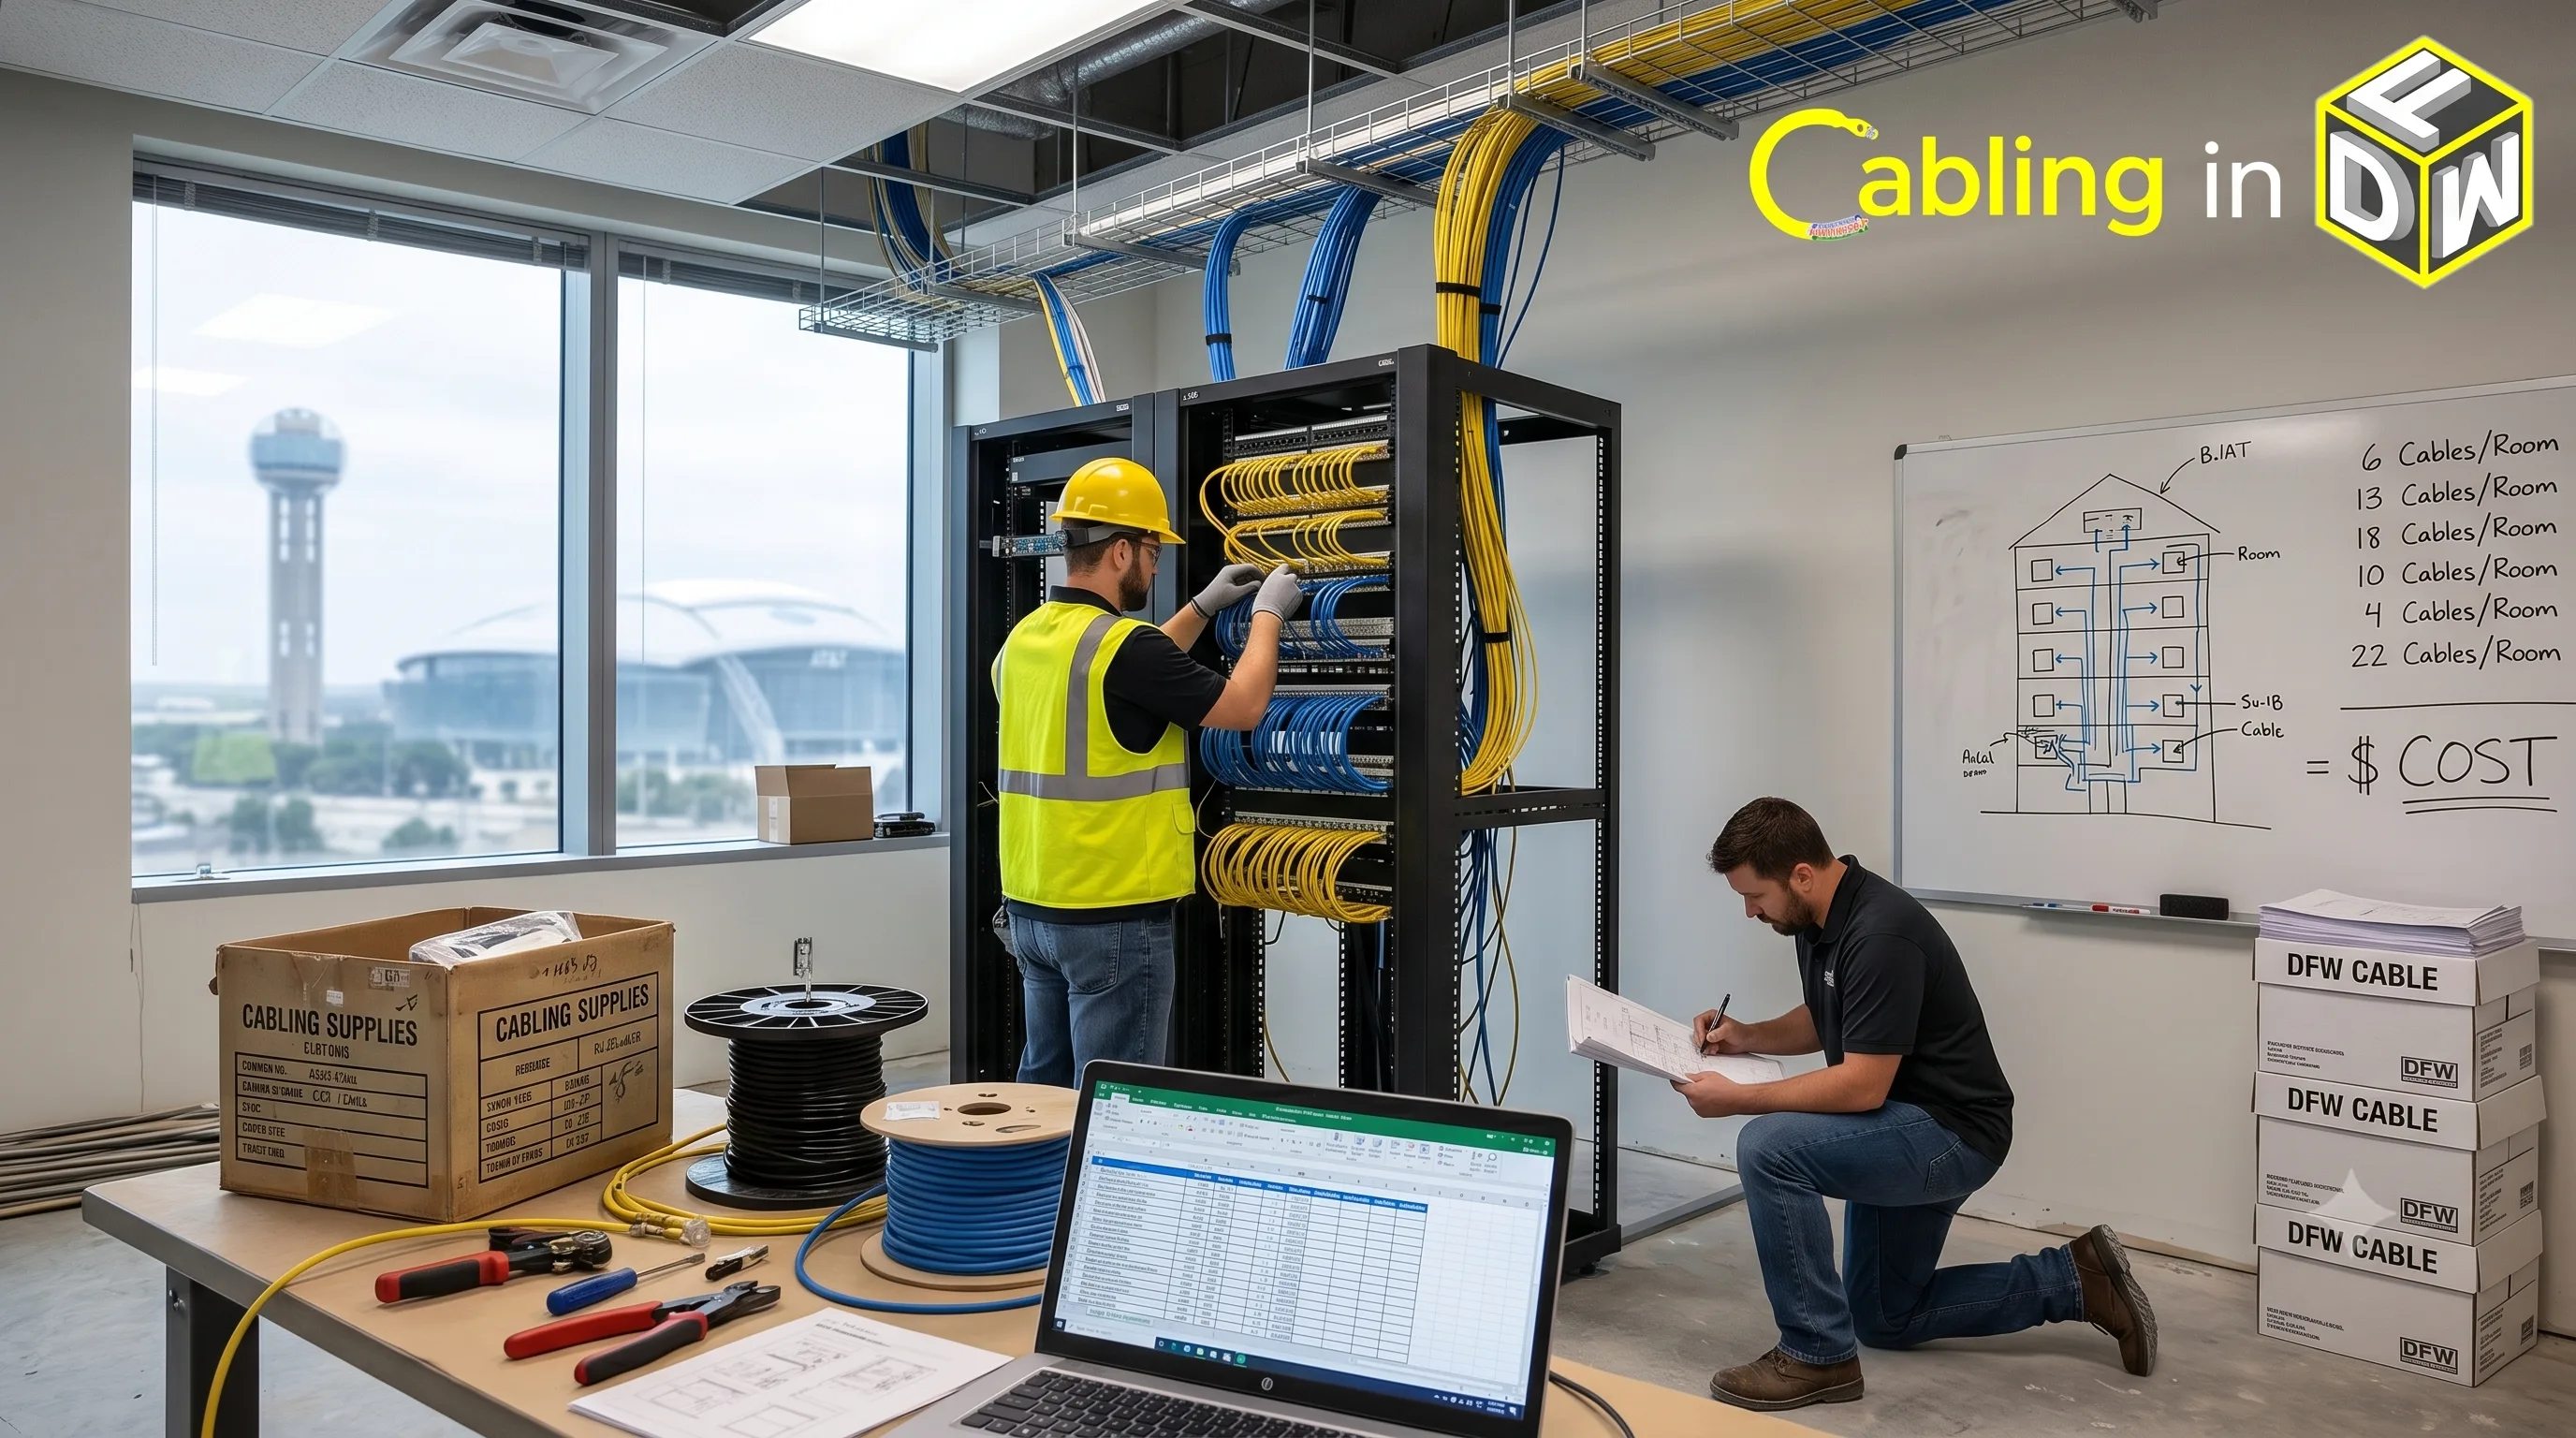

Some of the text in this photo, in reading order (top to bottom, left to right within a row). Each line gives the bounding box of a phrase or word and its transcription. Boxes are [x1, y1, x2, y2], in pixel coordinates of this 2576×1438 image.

[2362, 429, 2559, 471] 6 Cables/Room
[2357, 474, 2559, 510] 13 Cables/Room
[2357, 513, 2558, 550] 18 Cables/Room
[2238, 546, 2281, 562] Room
[2358, 552, 2558, 588] 10 Cables/Room
[2364, 592, 2558, 628] 4 Cables/Room
[2350, 634, 2561, 668] 22 Cables/Room
[2348, 736, 2378, 795] $
[2398, 734, 2558, 787] COST
[2287, 952, 2438, 991] DFW CABLE
[242, 1003, 417, 1047] CABLING SUPPLIES
[495, 983, 650, 1043] CABLING SUPPLIES
[2404, 1059, 2454, 1079] DFW
[2287, 1087, 2438, 1134] DFW CABLE
[2404, 1200, 2454, 1224] DFW
[2287, 1221, 2438, 1275] DFW CABLE
[2403, 1340, 2454, 1363] DFW
